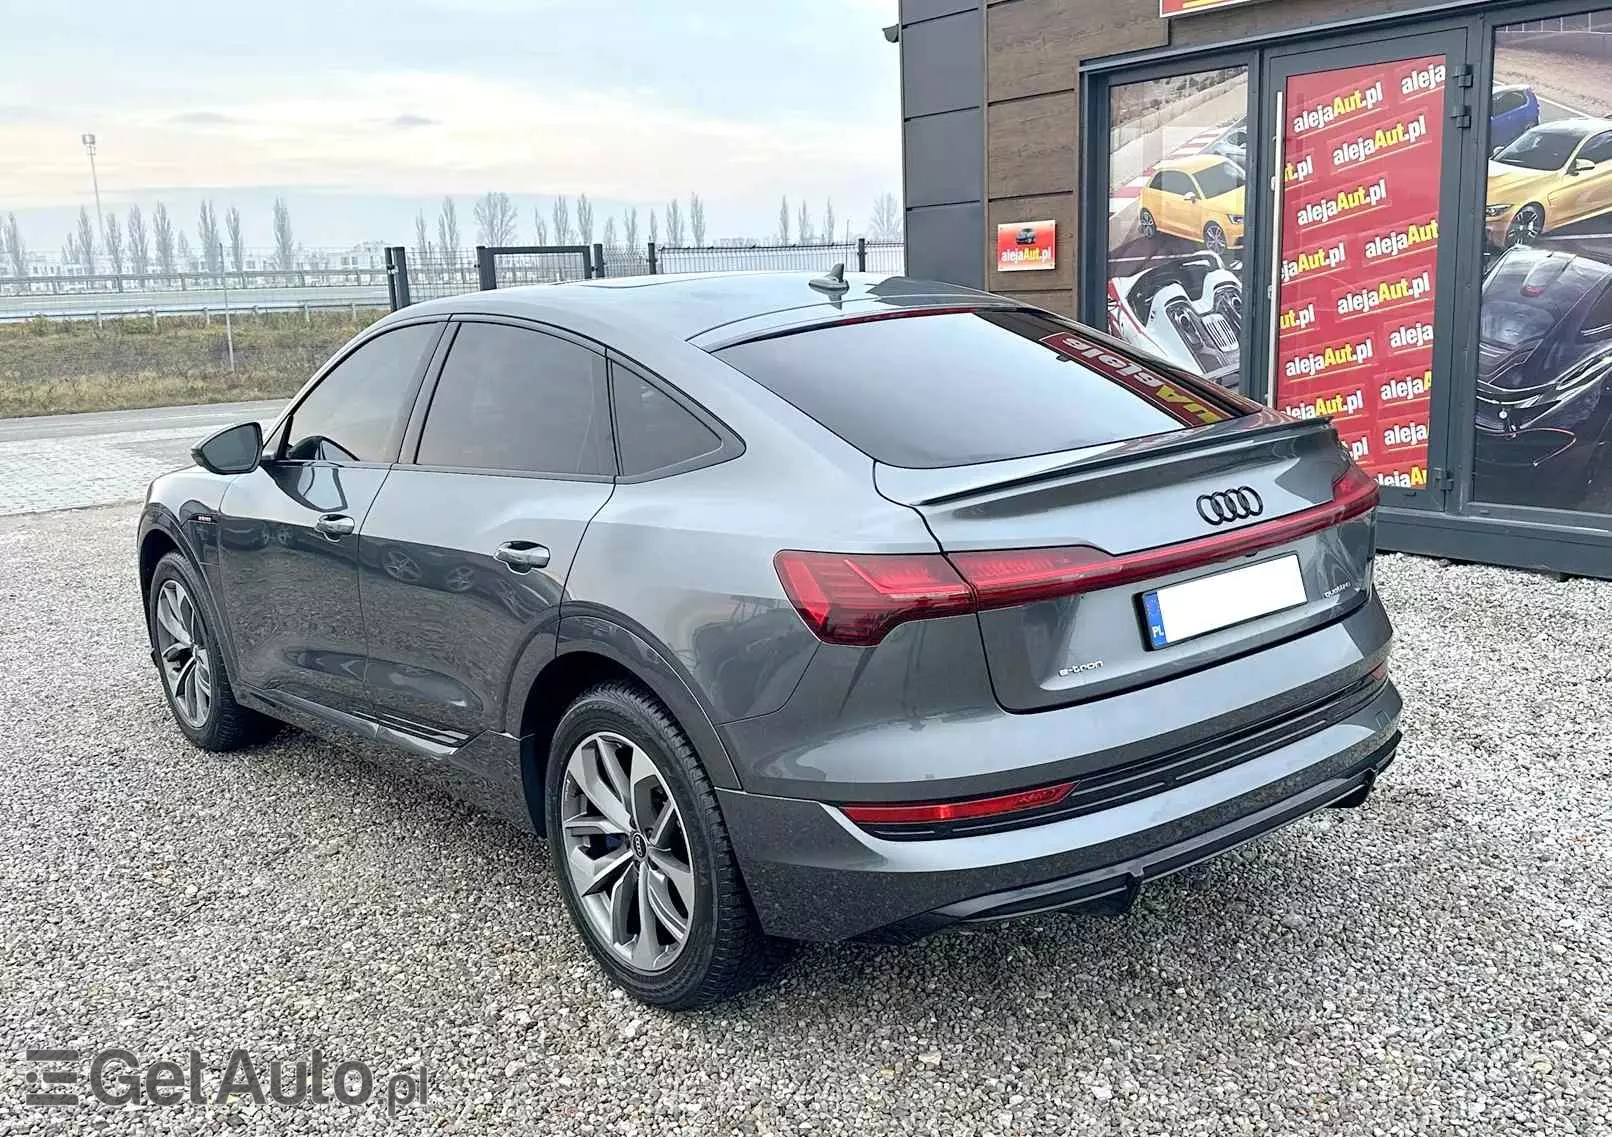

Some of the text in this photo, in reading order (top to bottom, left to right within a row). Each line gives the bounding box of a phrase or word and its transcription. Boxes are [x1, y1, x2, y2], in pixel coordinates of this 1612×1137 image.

[1401, 63, 1445, 94] aleja
[1293, 80, 1383, 132] alejaAut.pl
[1332, 114, 1426, 165] alejaAut.pl
[1297, 178, 1387, 226] alejaAut.pl
[1001, 246, 1052, 263] alejaAut.pl
[1337, 271, 1430, 314] alejaAut.pl
[1390, 321, 1433, 348] aleja
[1285, 338, 1373, 376] alejaAut.pl
[1152, 625, 1165, 638] PL
[1059, 660, 1104, 676] e-tron
